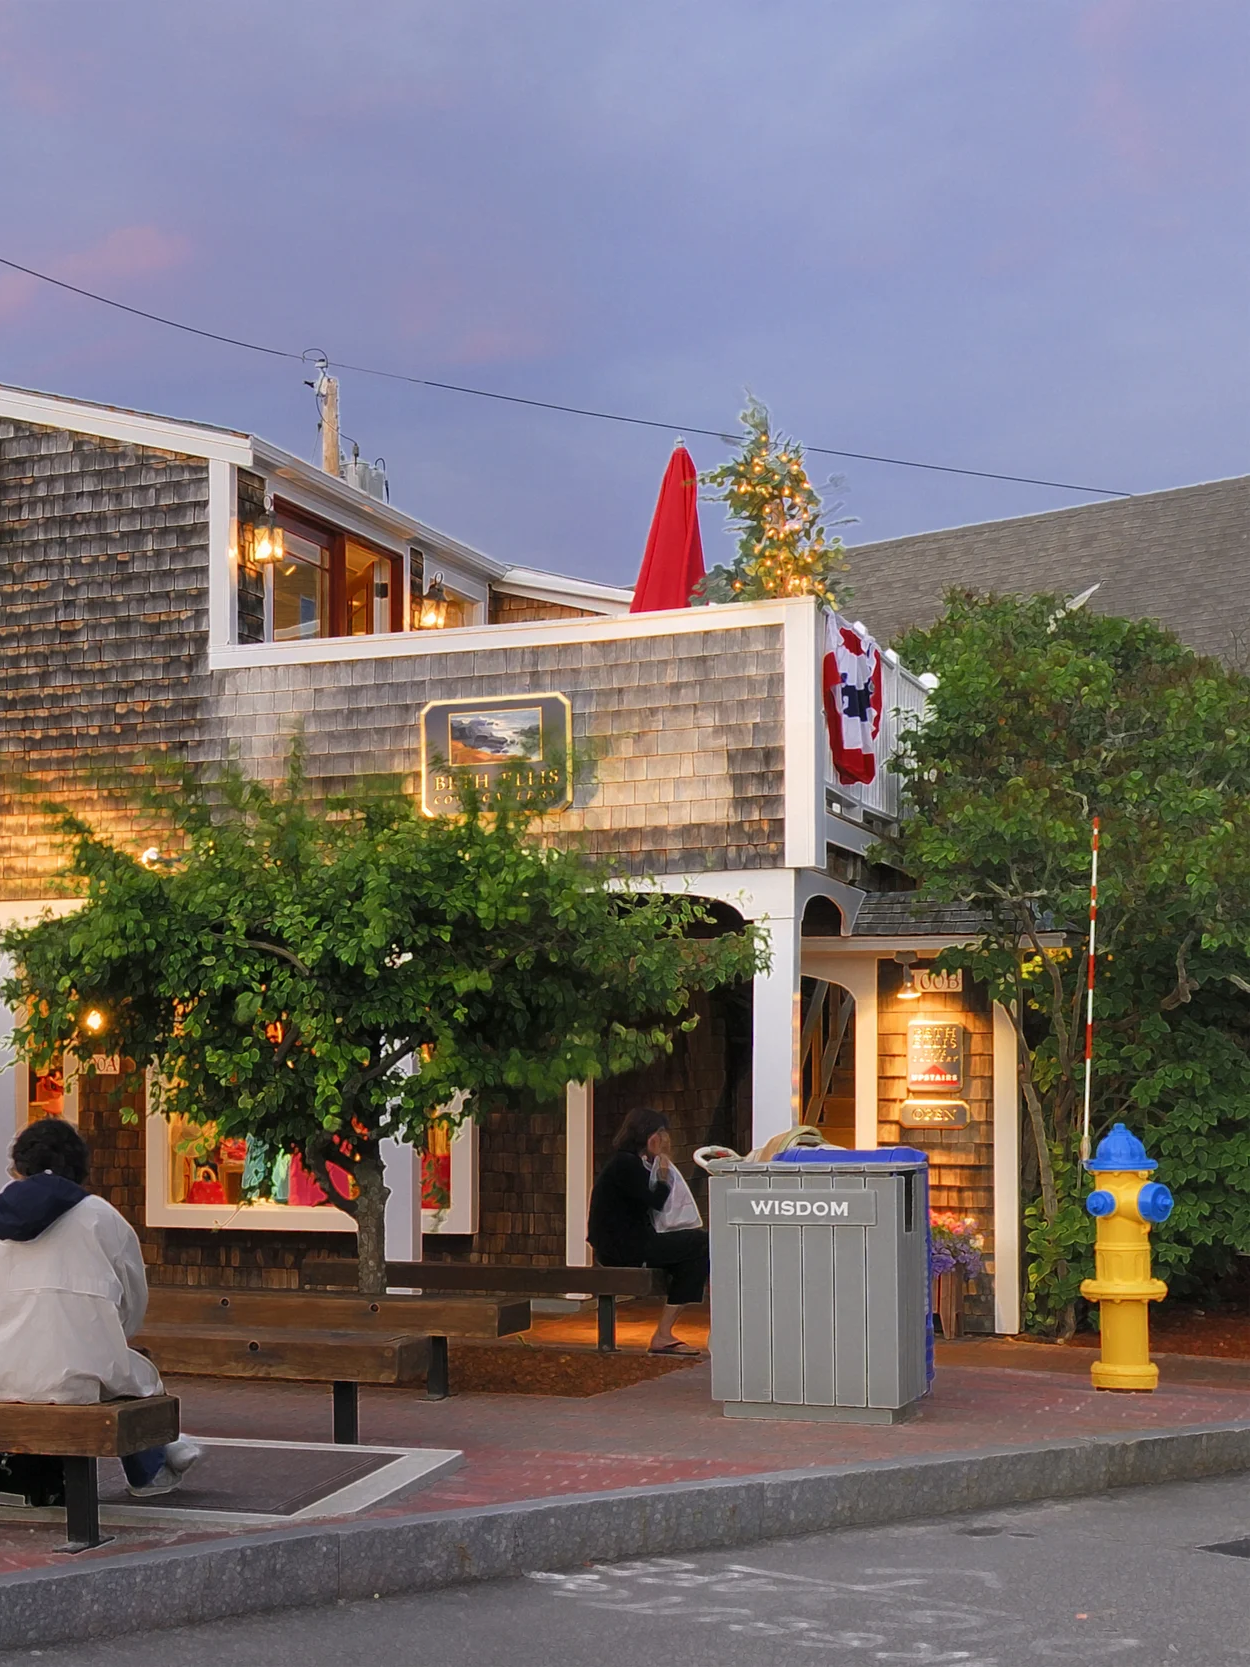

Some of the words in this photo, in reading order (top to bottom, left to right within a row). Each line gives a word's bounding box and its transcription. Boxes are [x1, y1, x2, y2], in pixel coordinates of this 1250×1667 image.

[912, 972, 960, 990] 00B
[910, 1073, 958, 1082] UPSTAIRS
[912, 1107, 957, 1121] OPEN
[750, 1199, 849, 1217] WISDOM
